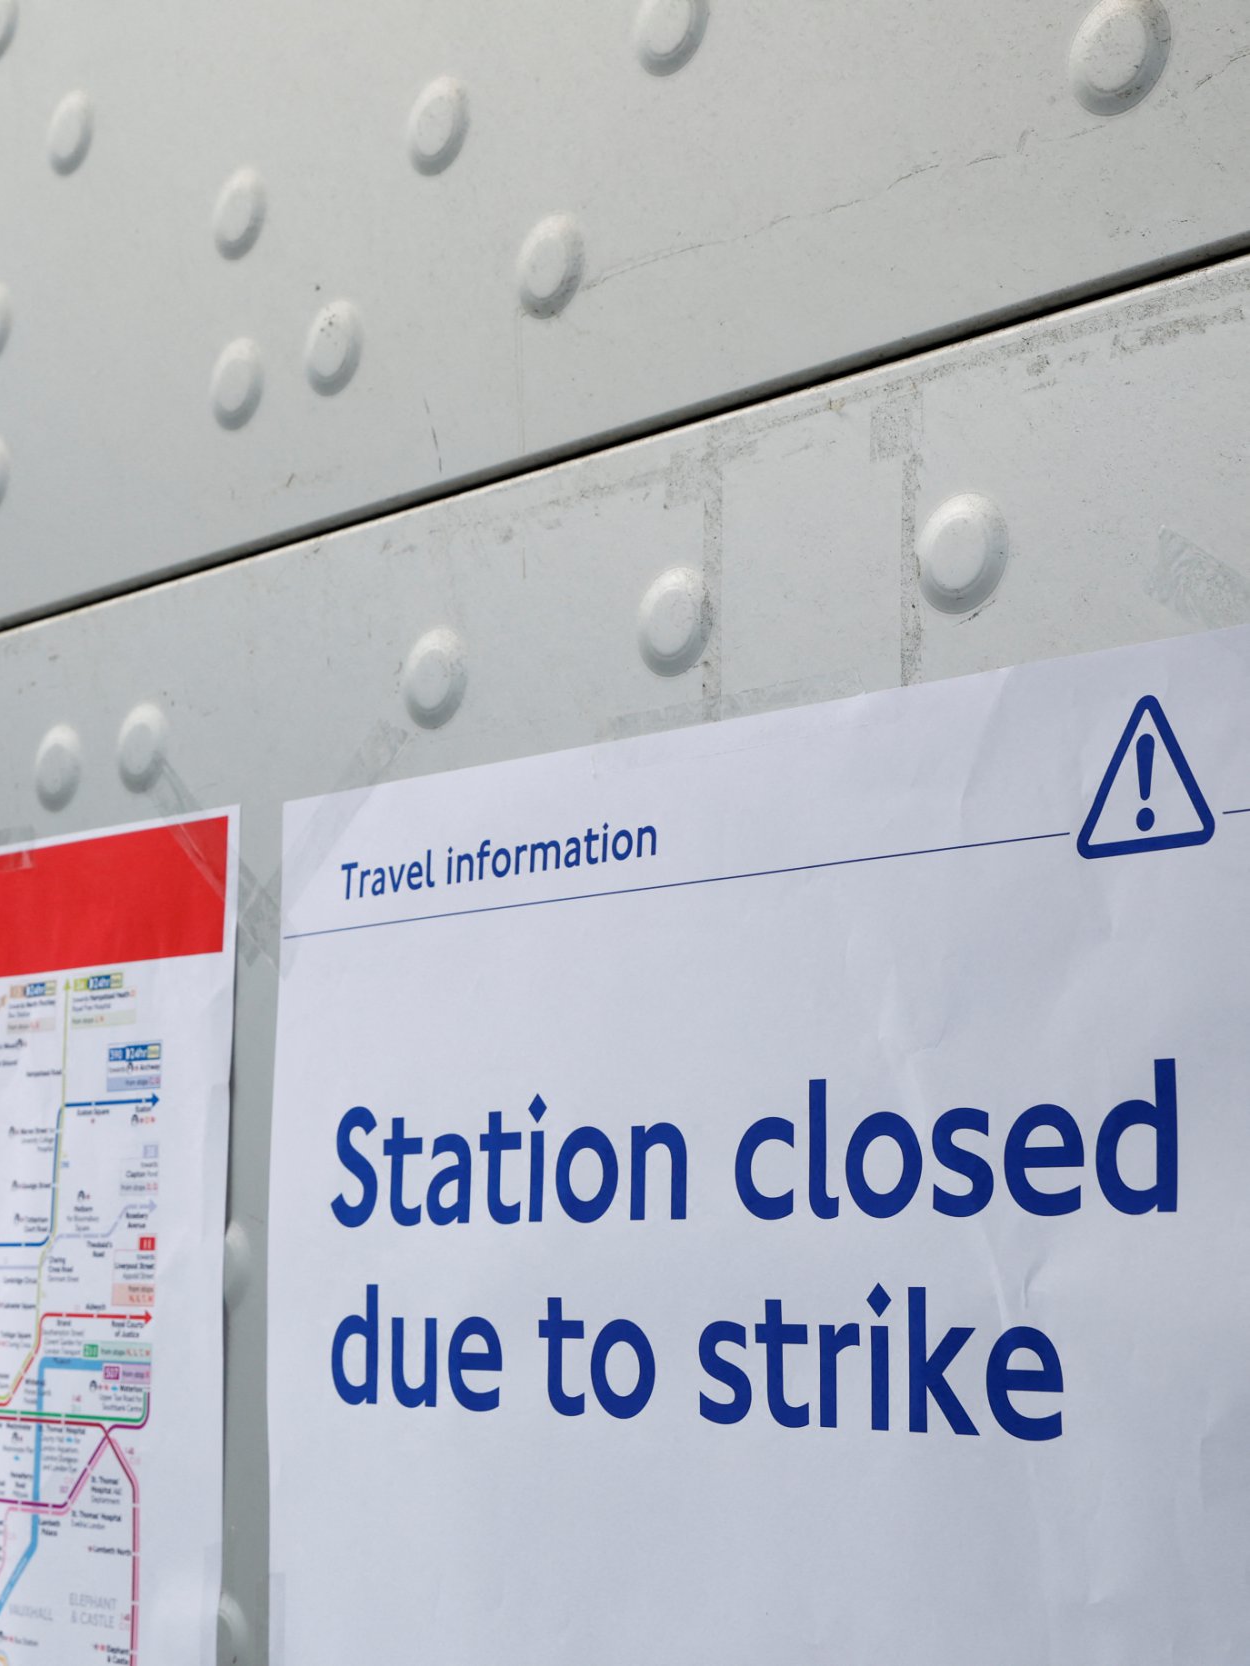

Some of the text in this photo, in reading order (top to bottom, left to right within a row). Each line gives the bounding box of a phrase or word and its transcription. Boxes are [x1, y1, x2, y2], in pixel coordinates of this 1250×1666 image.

[341, 822, 658, 901] Travel information
[330, 1057, 1178, 1228] Station closed
[331, 1282, 1065, 1442] due to strike
[69, 1592, 117, 1611] ELEPHANT
[80, 1612, 115, 1630] CASTLE
